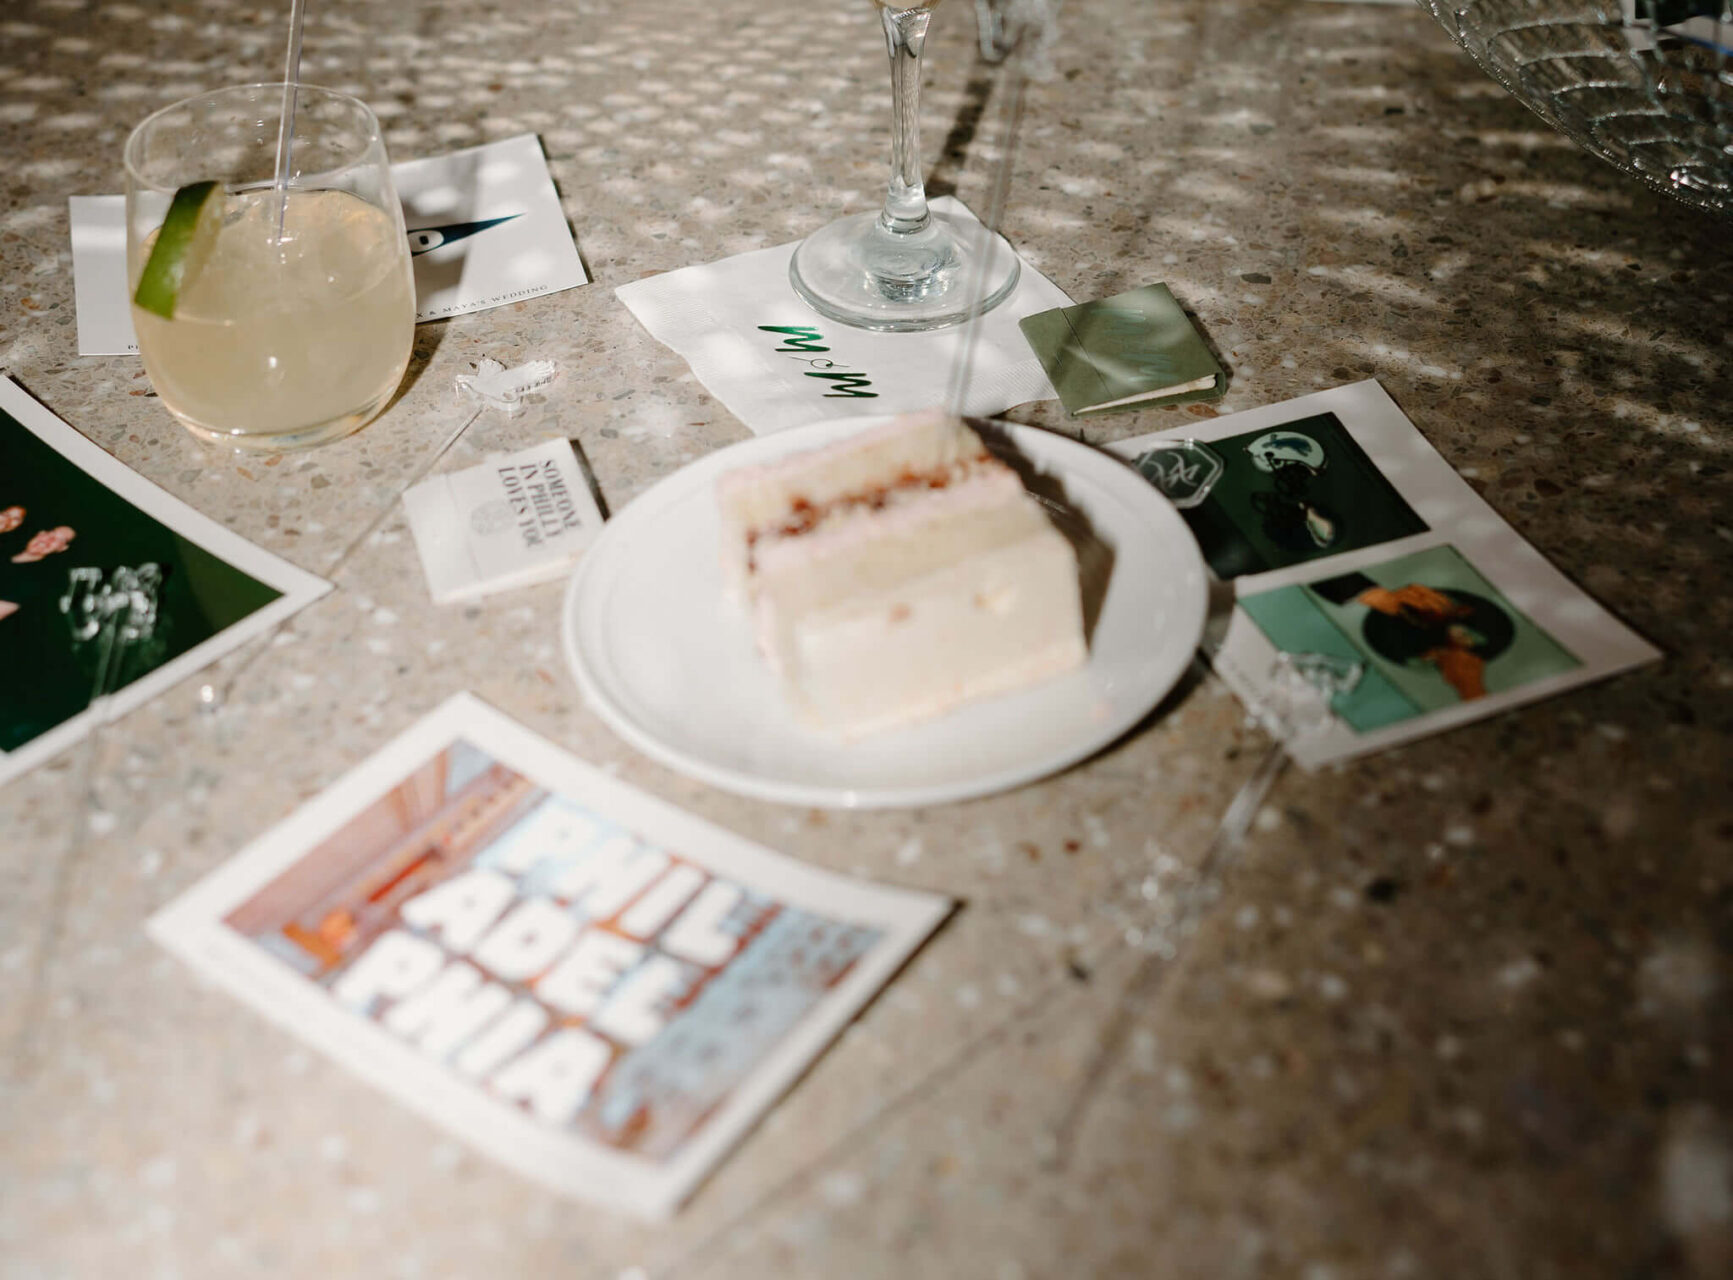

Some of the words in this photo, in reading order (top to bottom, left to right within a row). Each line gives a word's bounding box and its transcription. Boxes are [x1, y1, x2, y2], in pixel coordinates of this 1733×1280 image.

[492, 285, 548, 303] WEDDING
[498, 466, 529, 515] LOVES
[519, 464, 539, 480] IN
[543, 459, 582, 530] SOMEONE
[527, 483, 564, 538] PHILLY
[401, 868, 686, 1048] ADEL
